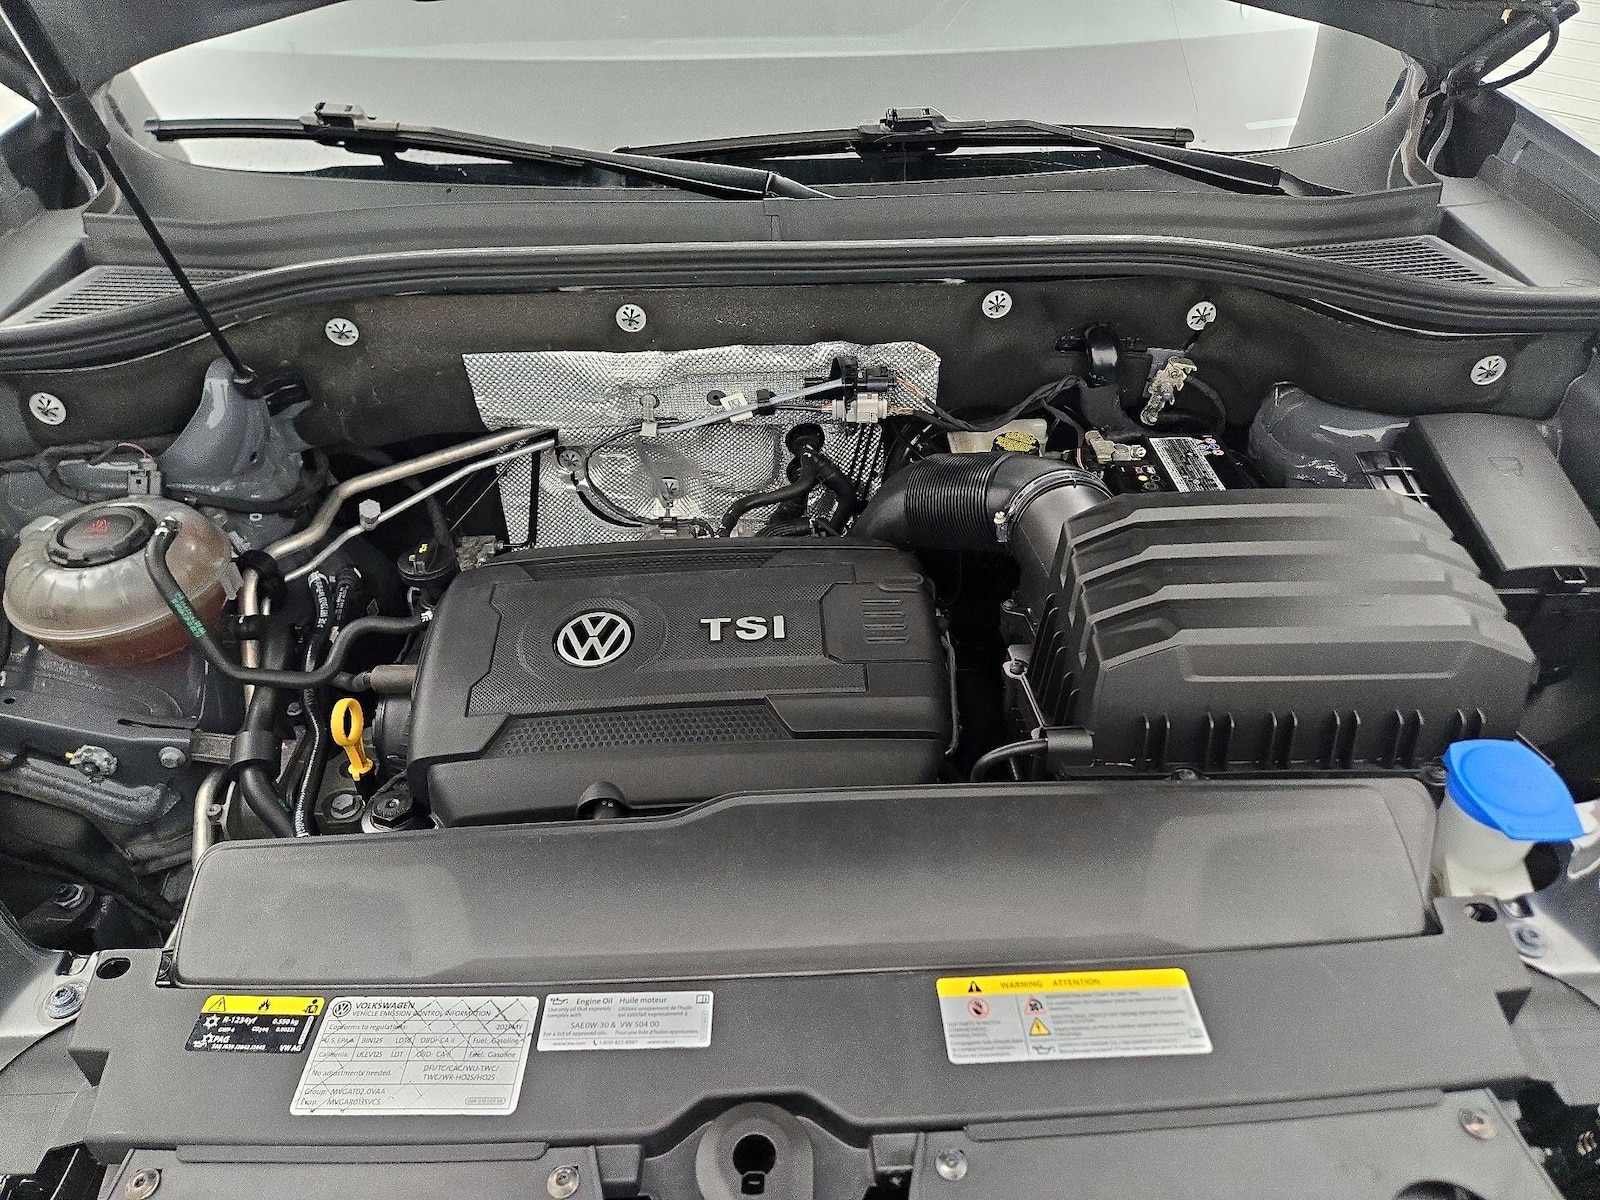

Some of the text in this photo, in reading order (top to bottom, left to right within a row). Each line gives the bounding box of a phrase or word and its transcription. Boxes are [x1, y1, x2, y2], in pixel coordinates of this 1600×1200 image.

[700, 615, 786, 642] TSI
[356, 1001, 415, 1009] VOLKSWAGEN
[576, 998, 601, 1006] Engine
[222, 1016, 258, 1026] R-1234yf
[291, 1018, 299, 1026] kg
[214, 1035, 230, 1043] PAG
[473, 1036, 519, 1045] Fuel: Gasoline
[469, 1050, 484, 1058] Fuel:
[304, 1088, 327, 1096] Group:
